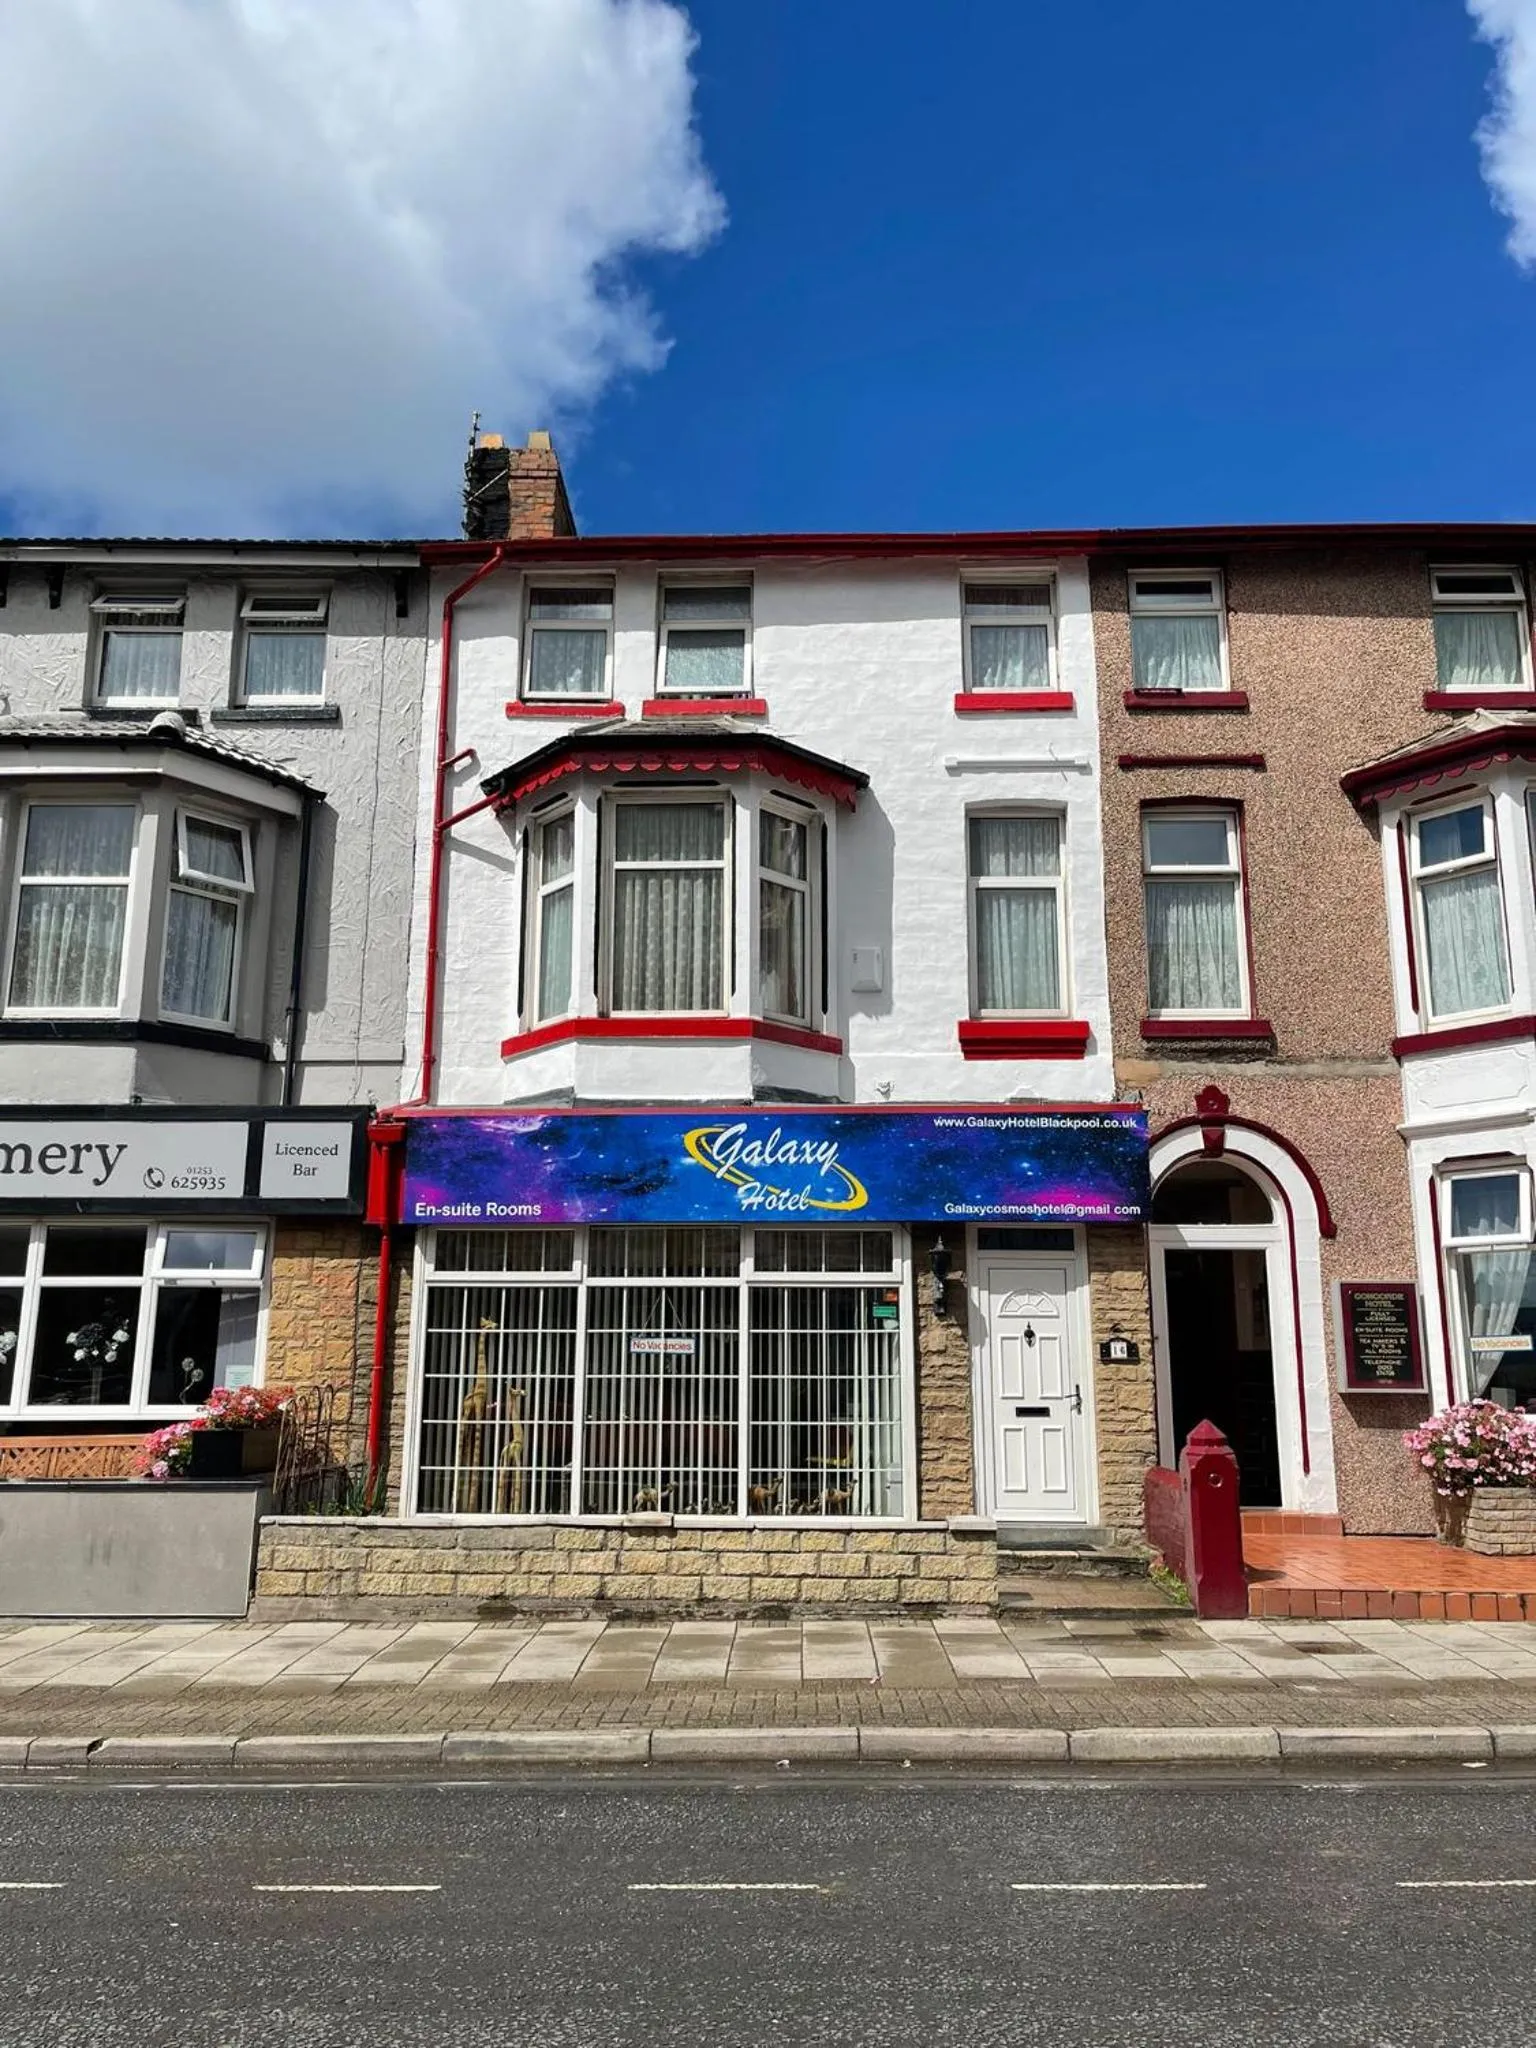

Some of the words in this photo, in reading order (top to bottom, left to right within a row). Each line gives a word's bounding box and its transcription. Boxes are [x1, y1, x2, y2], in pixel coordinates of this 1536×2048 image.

[934, 1116, 1137, 1130] www.GalaxyHotelBlackpool.co.uk
[275, 1143, 339, 1156] Licenced
[712, 1123, 838, 1179] Galaxy
[292, 1164, 317, 1177] Bar
[171, 1176, 226, 1190] 625935
[737, 1182, 811, 1212] Hotel
[415, 1202, 481, 1216] En-suite
[486, 1202, 542, 1216] Rooms
[632, 1341, 646, 1350] No
[647, 1341, 691, 1351] Vacancies
